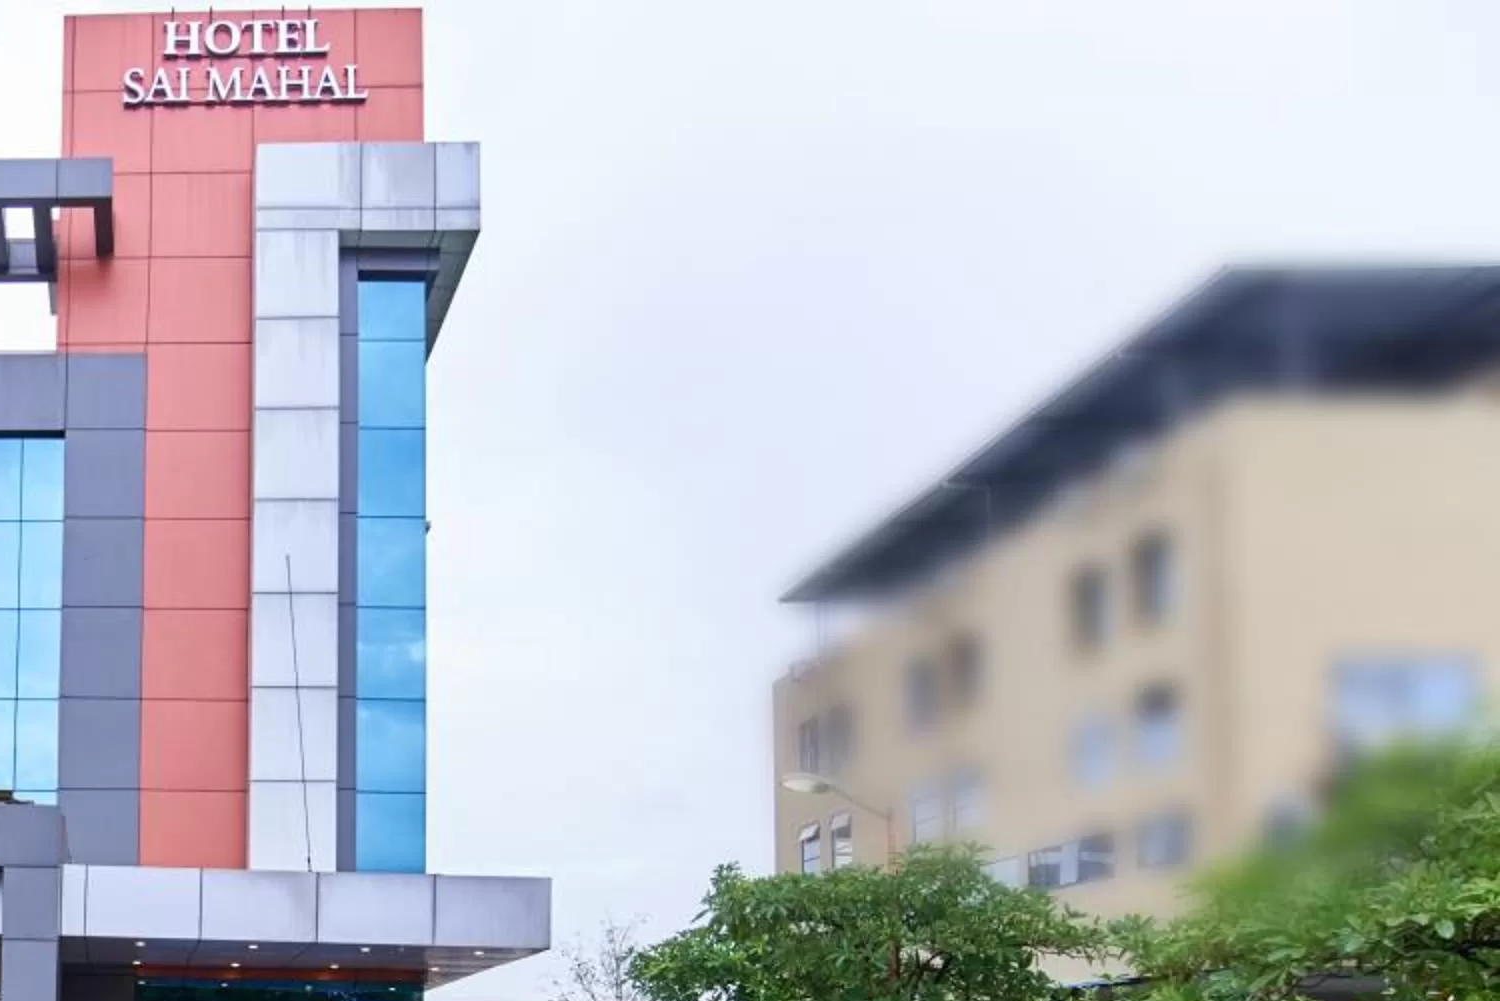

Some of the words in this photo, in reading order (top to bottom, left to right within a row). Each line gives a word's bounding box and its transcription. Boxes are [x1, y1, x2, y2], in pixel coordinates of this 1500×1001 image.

[163, 19, 331, 56] HOTEL
[122, 66, 191, 104] SAI
[206, 64, 369, 103] MAHAL
